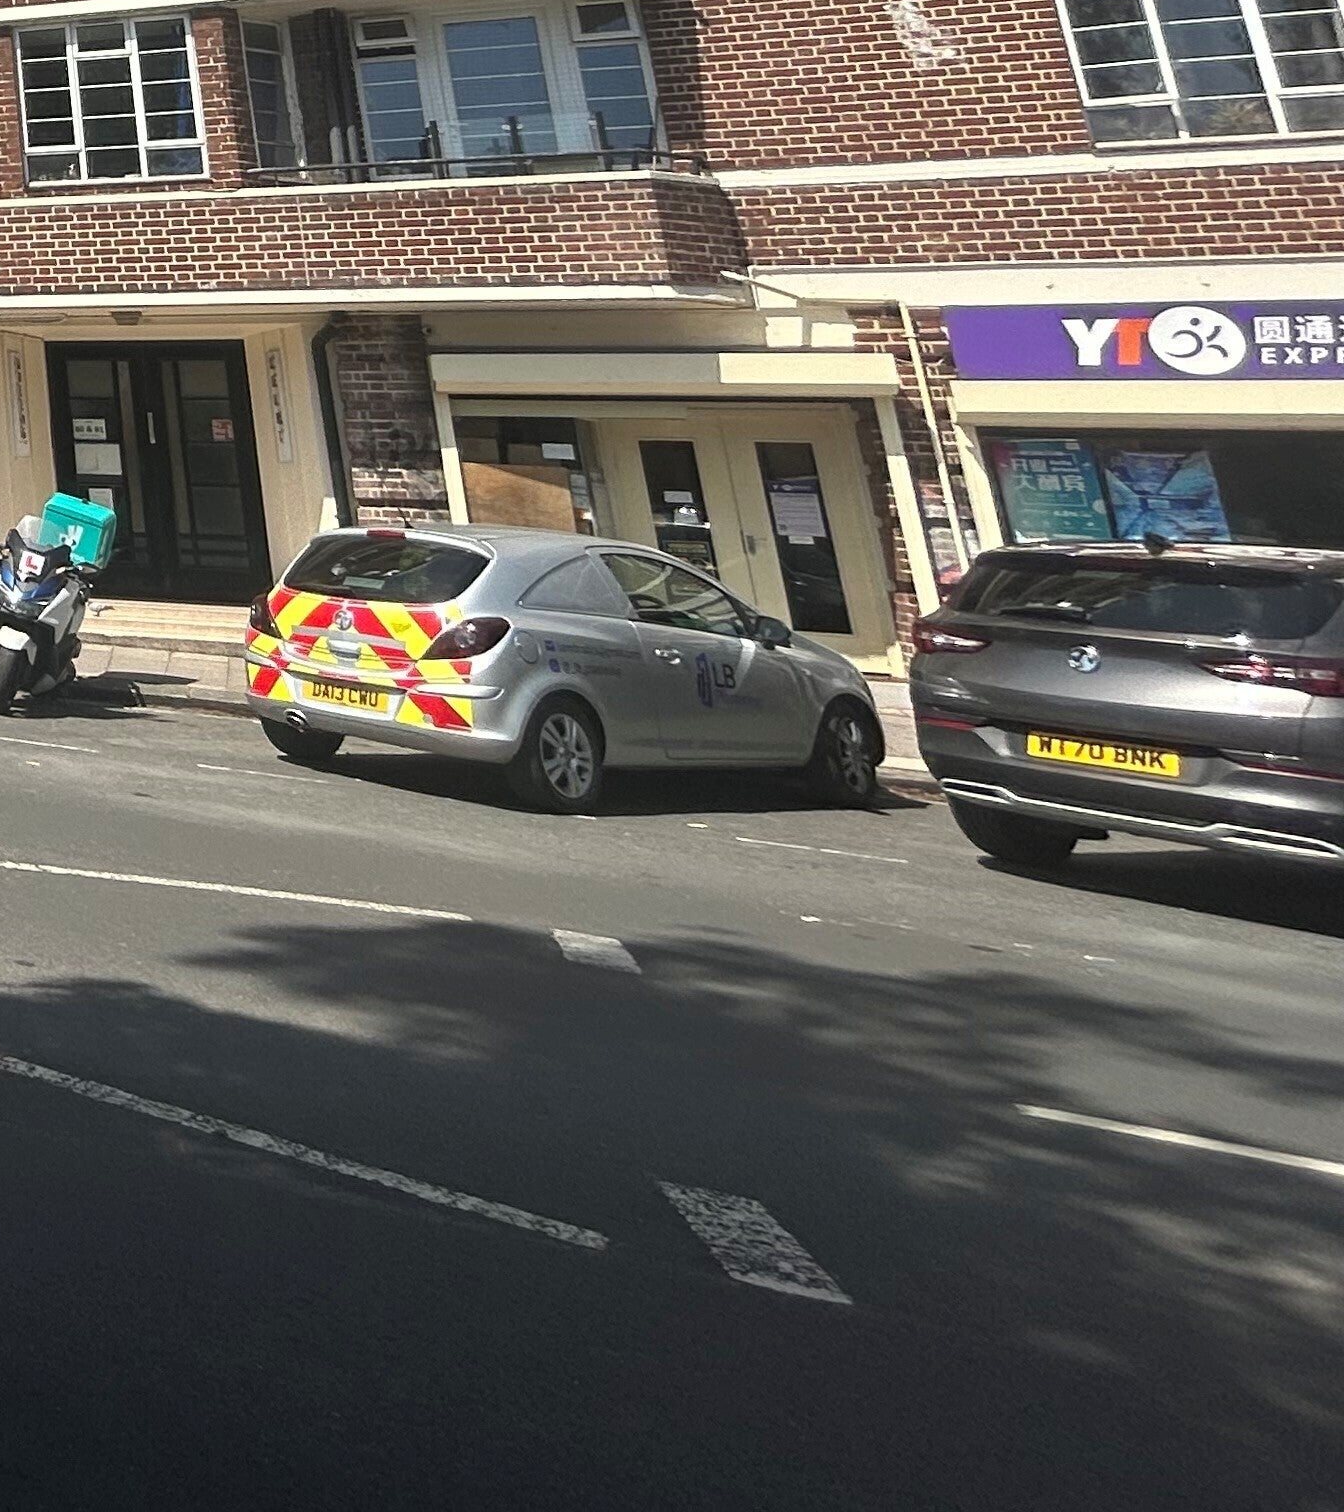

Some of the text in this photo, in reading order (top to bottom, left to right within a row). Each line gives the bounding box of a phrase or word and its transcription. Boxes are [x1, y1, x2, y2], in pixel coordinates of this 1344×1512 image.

[712, 661, 737, 689] LB
[312, 683, 345, 701] DA13
[1113, 747, 1166, 770] BNK
